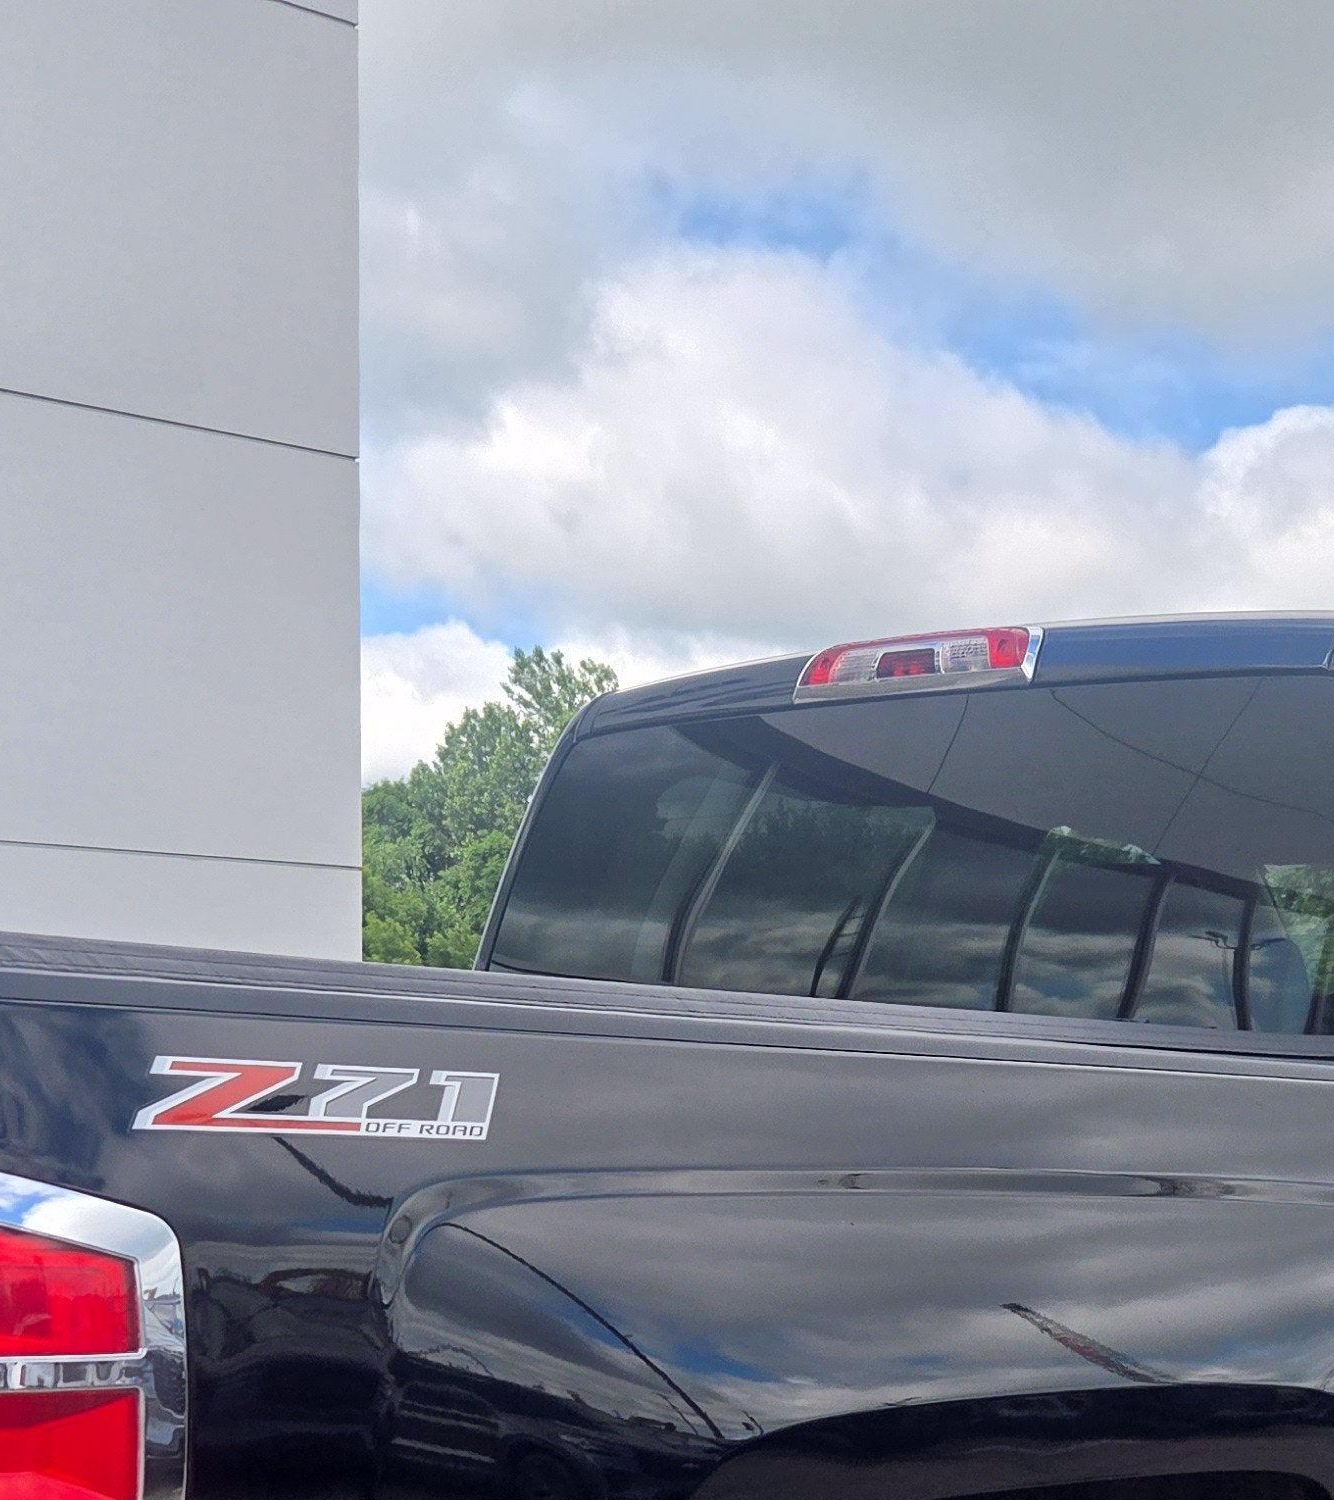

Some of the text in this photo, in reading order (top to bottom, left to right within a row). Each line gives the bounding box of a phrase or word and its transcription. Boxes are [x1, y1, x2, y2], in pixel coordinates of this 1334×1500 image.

[132, 1054, 500, 1135] Z71
[365, 1122, 484, 1137] OFF ROAD
